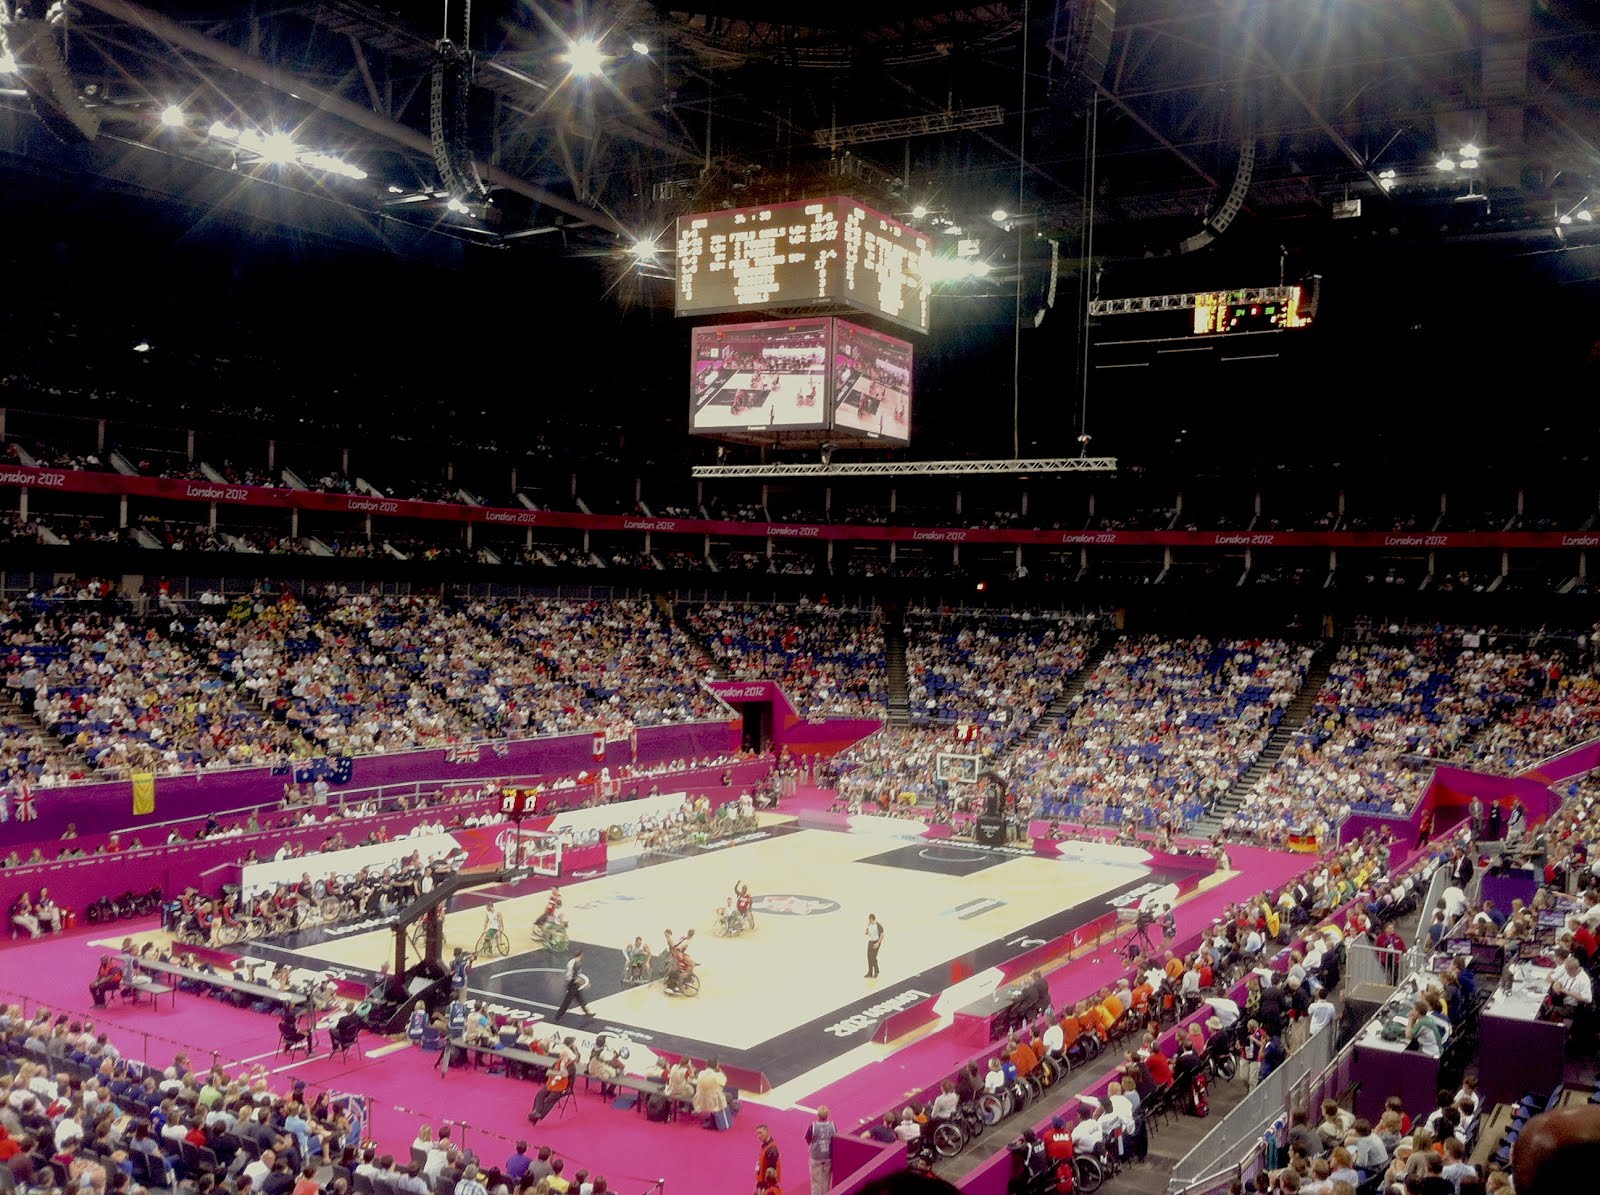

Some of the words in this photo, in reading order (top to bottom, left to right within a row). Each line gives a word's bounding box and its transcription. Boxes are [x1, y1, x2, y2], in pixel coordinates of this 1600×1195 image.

[0, 470, 36, 485] ondon
[38, 473, 66, 487] 2012
[187, 484, 223, 499] London
[225, 488, 249, 500] 2012
[348, 499, 379, 511] London
[379, 503, 399, 513] 2012
[486, 511, 517, 522] London
[517, 514, 537, 523] 2012
[624, 519, 655, 530] London
[656, 521, 676, 531] 2012
[767, 526, 799, 536] London
[799, 527, 820, 537] 2012
[913, 530, 945, 541] London
[945, 531, 967, 541] 2012
[1062, 533, 1095, 543] London
[1095, 533, 1117, 543] 2012
[1215, 534, 1250, 545] London
[1251, 534, 1275, 545] 2012
[1384, 536, 1422, 546] London
[1423, 535, 1448, 546] 2012
[1561, 535, 1599, 546] London
[744, 686, 766, 697] 2012
